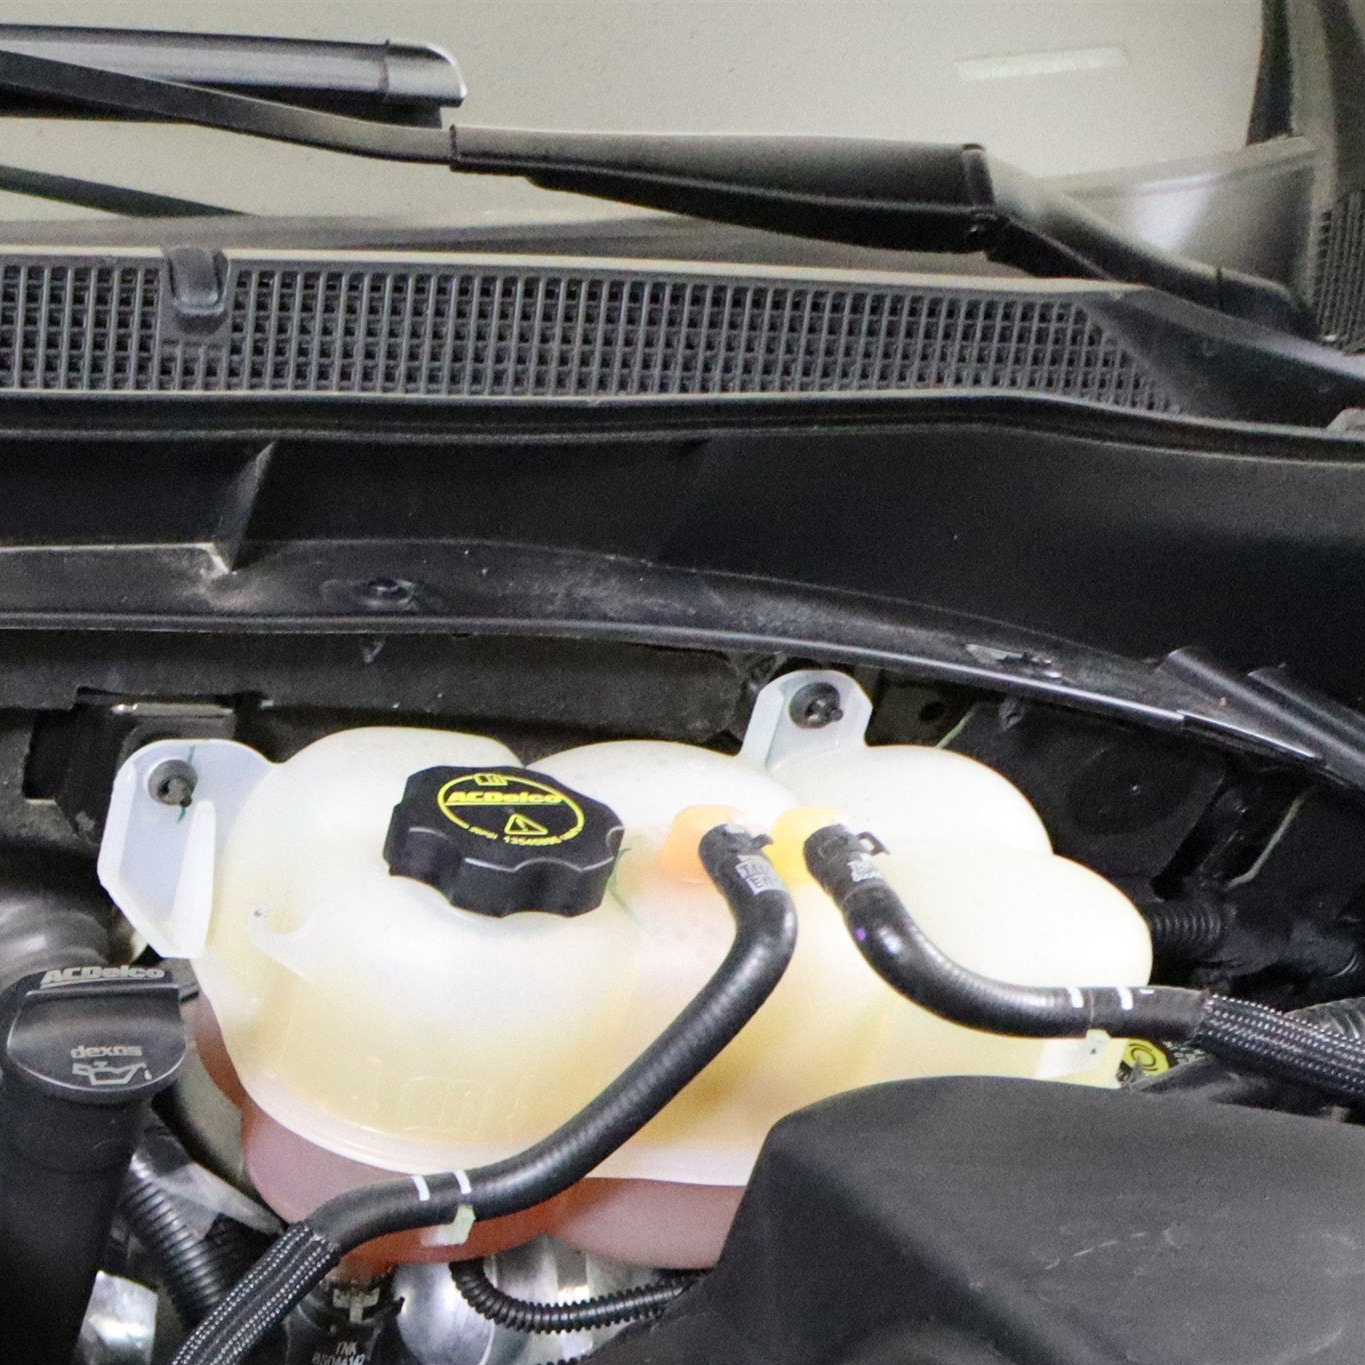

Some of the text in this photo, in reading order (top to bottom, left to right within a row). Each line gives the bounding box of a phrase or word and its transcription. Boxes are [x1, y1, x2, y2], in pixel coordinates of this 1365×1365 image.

[447, 791, 564, 805] ACDelco
[40, 965, 166, 987] ACDelco
[70, 1045, 143, 1059] dexos
